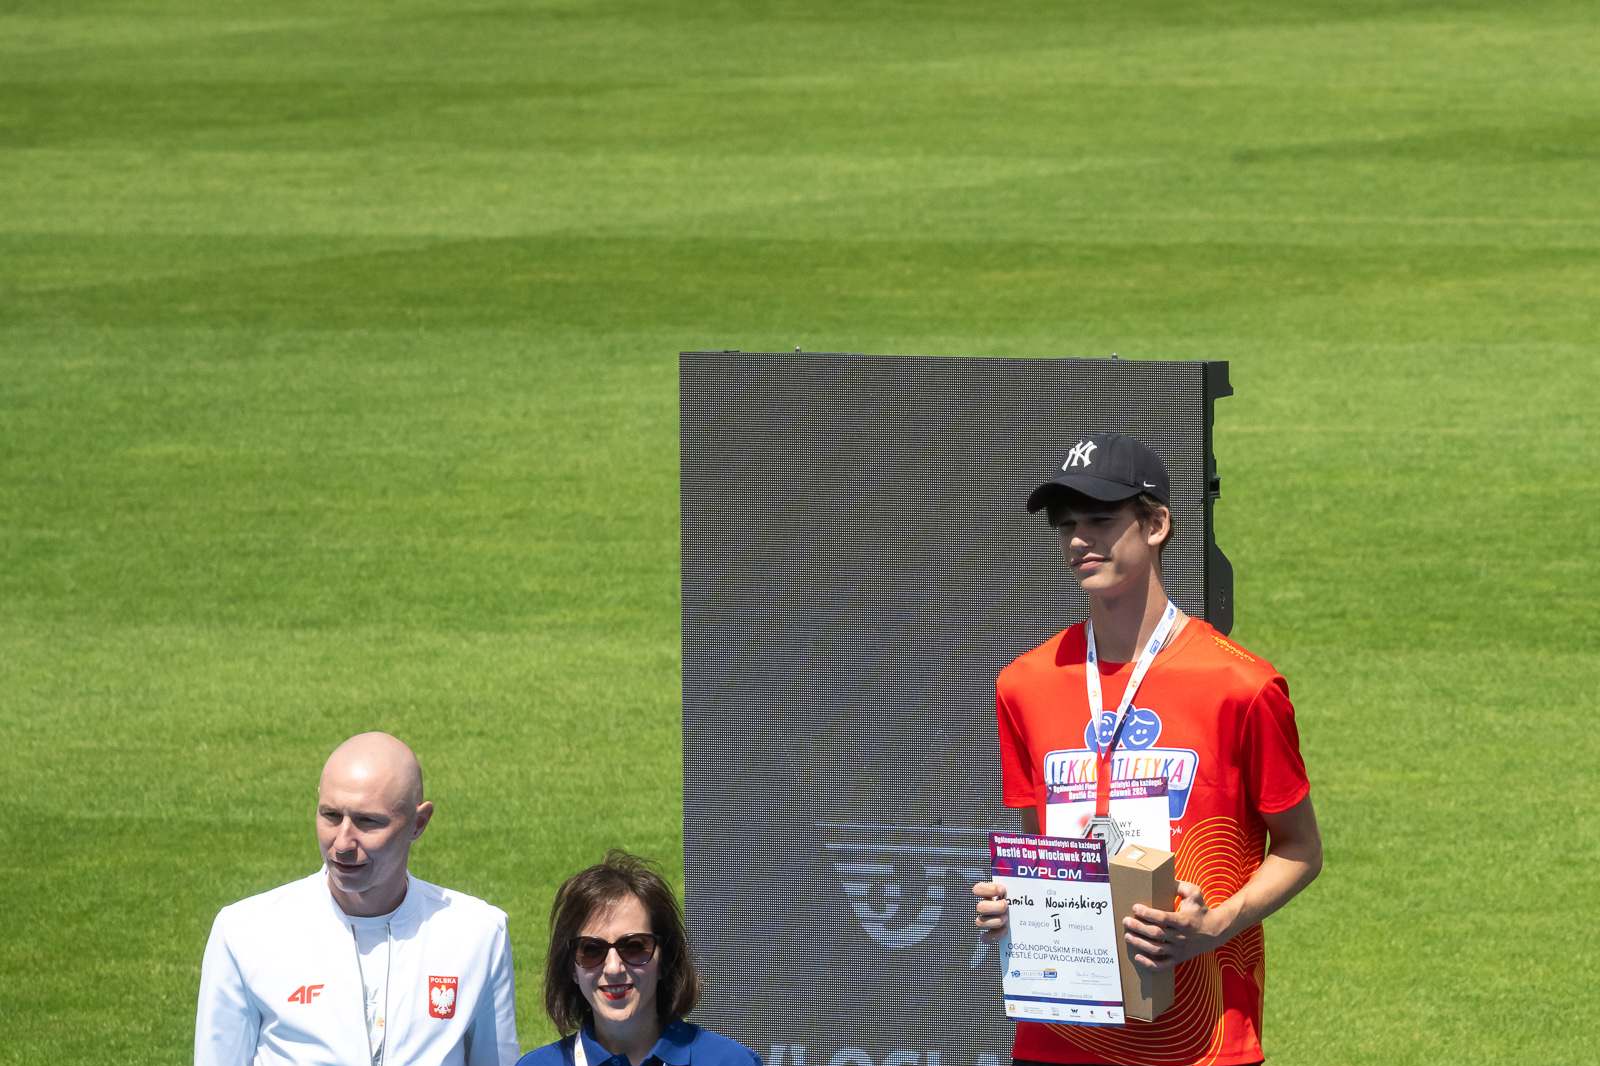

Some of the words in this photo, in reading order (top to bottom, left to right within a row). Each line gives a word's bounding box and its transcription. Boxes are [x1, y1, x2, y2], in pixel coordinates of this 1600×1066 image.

[1052, 758, 1184, 784] LEKKTLETYKA
[994, 836, 1025, 845] Ogólnopolski
[997, 847, 1020, 857] Nestlé
[1022, 848, 1036, 860] Cup
[1038, 849, 1080, 862] Włocławek
[1081, 853, 1101, 863] 2024
[1018, 866, 1082, 879] DYPLOM
[1045, 895, 1108, 915] Nowińskiego
[1028, 920, 1050, 928] zajęcie
[1069, 923, 1093, 931] miejsca
[1008, 942, 1070, 953] OGÓLNOPOLSKIM
[1072, 947, 1092, 955] FINAŁ
[1049, 955, 1096, 964] WŁOCŁAWEK
[430, 977, 457, 985] POLSKA
[287, 984, 324, 1005] 4F
